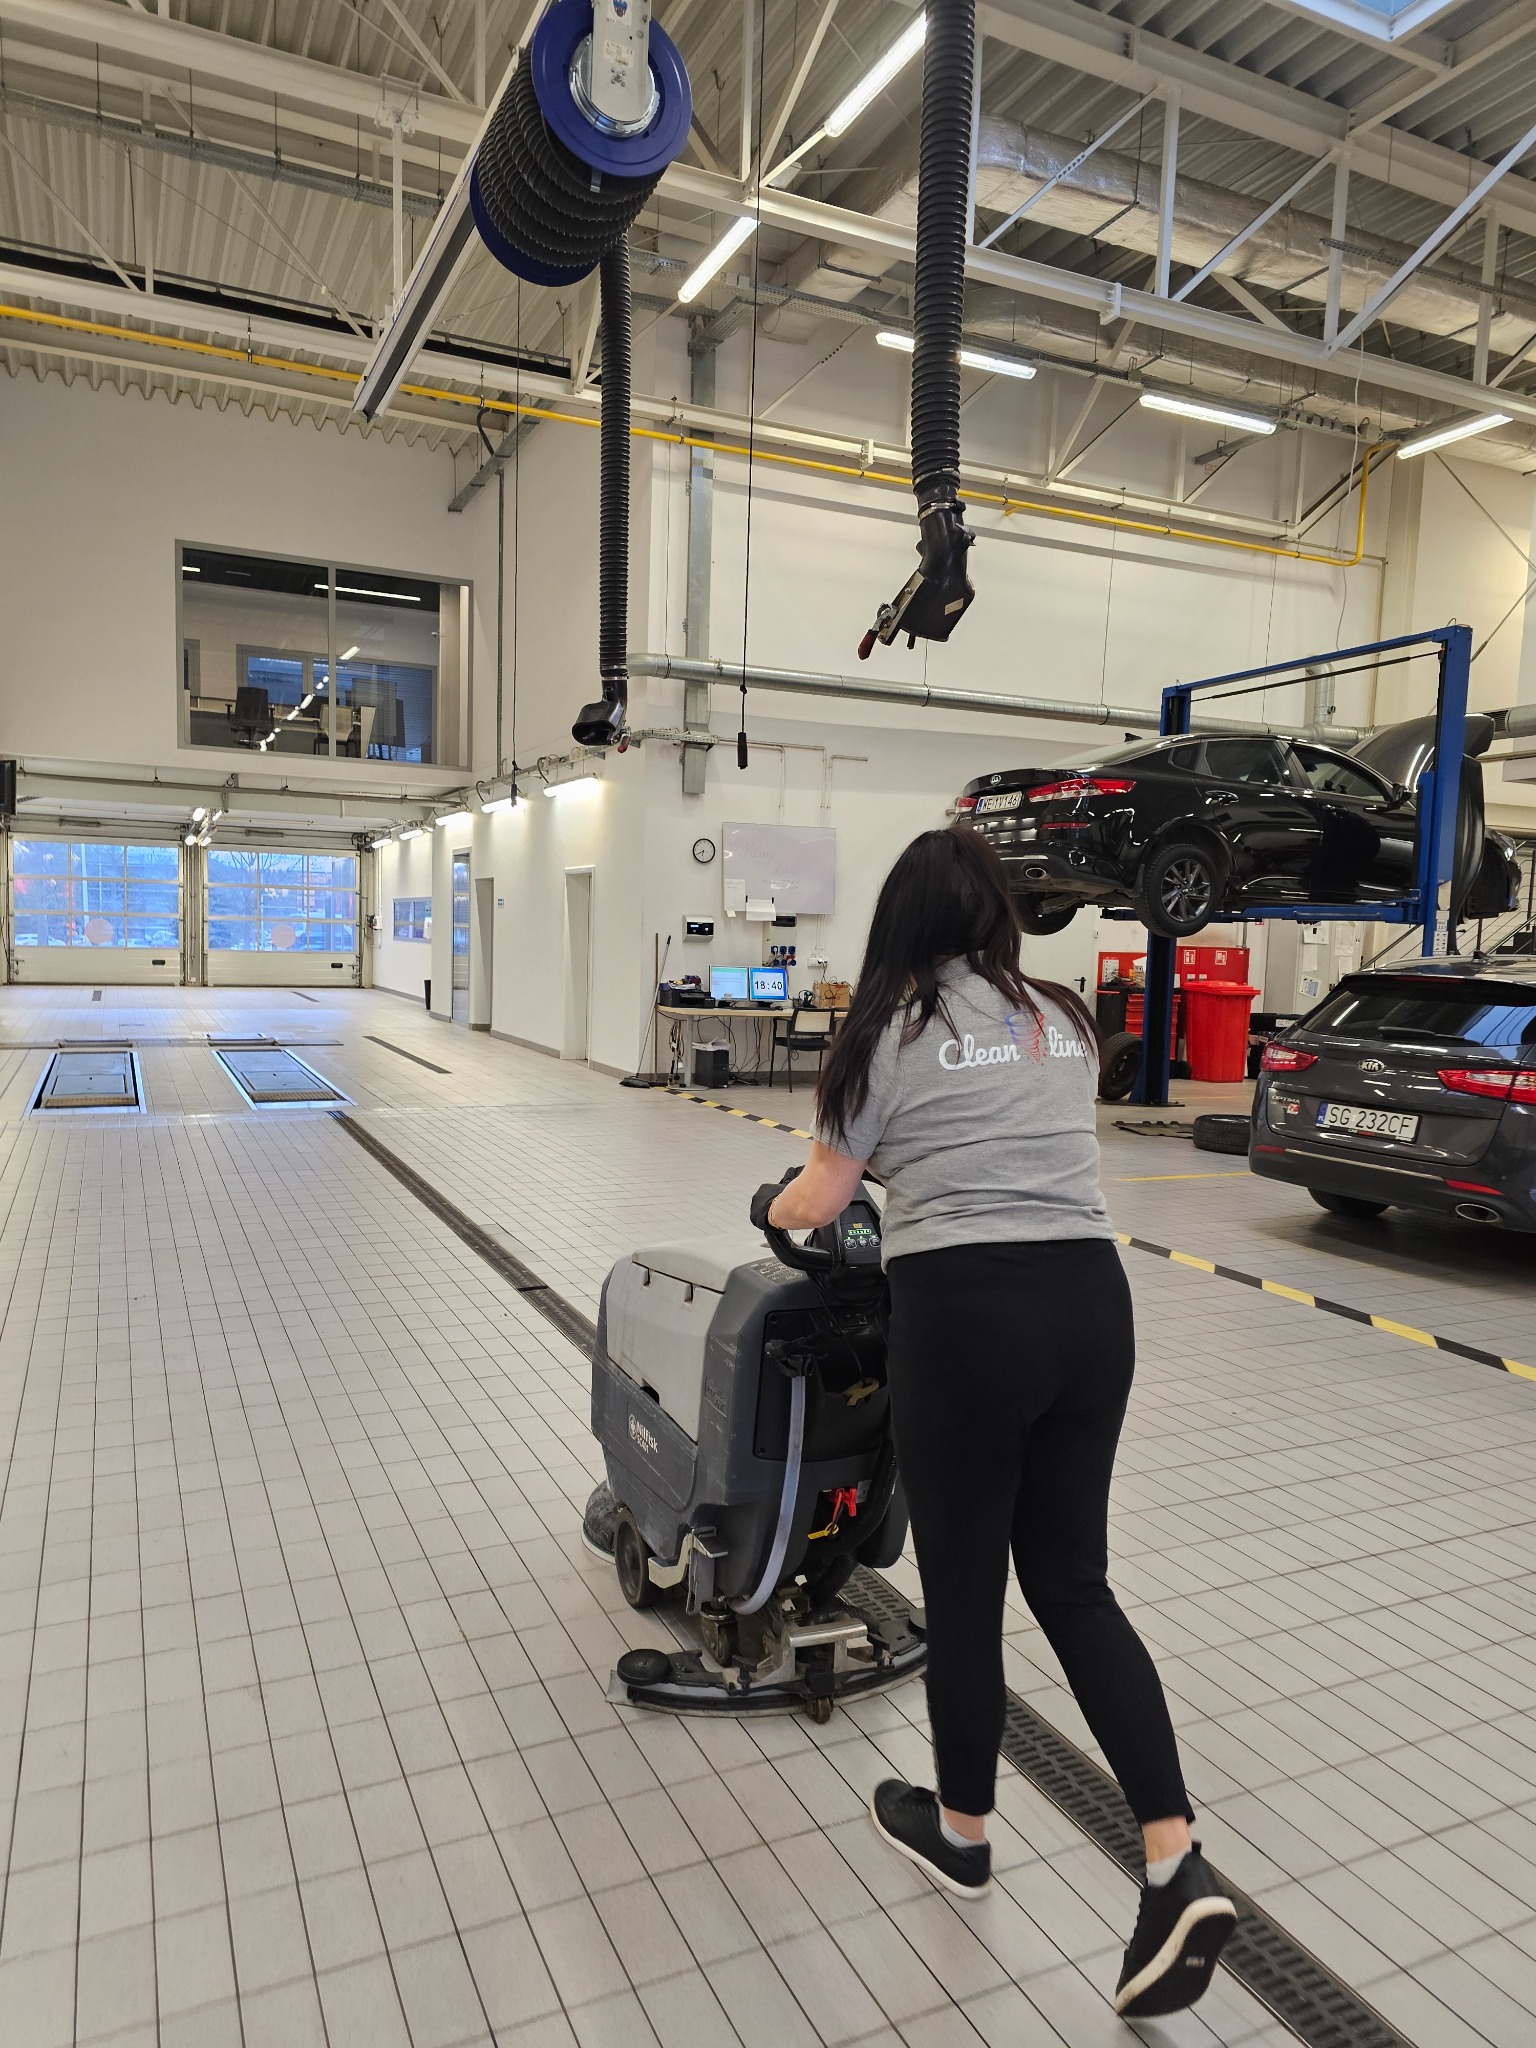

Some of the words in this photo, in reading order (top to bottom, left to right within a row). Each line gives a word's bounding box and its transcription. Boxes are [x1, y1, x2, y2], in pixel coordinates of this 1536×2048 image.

[755, 980, 783, 990] 18:40
[938, 1033, 1022, 1071] Clean
[1361, 1061, 1379, 1071] KIA
[1328, 1106, 1352, 1126] SG
[1355, 1110, 1413, 1135] 232CF
